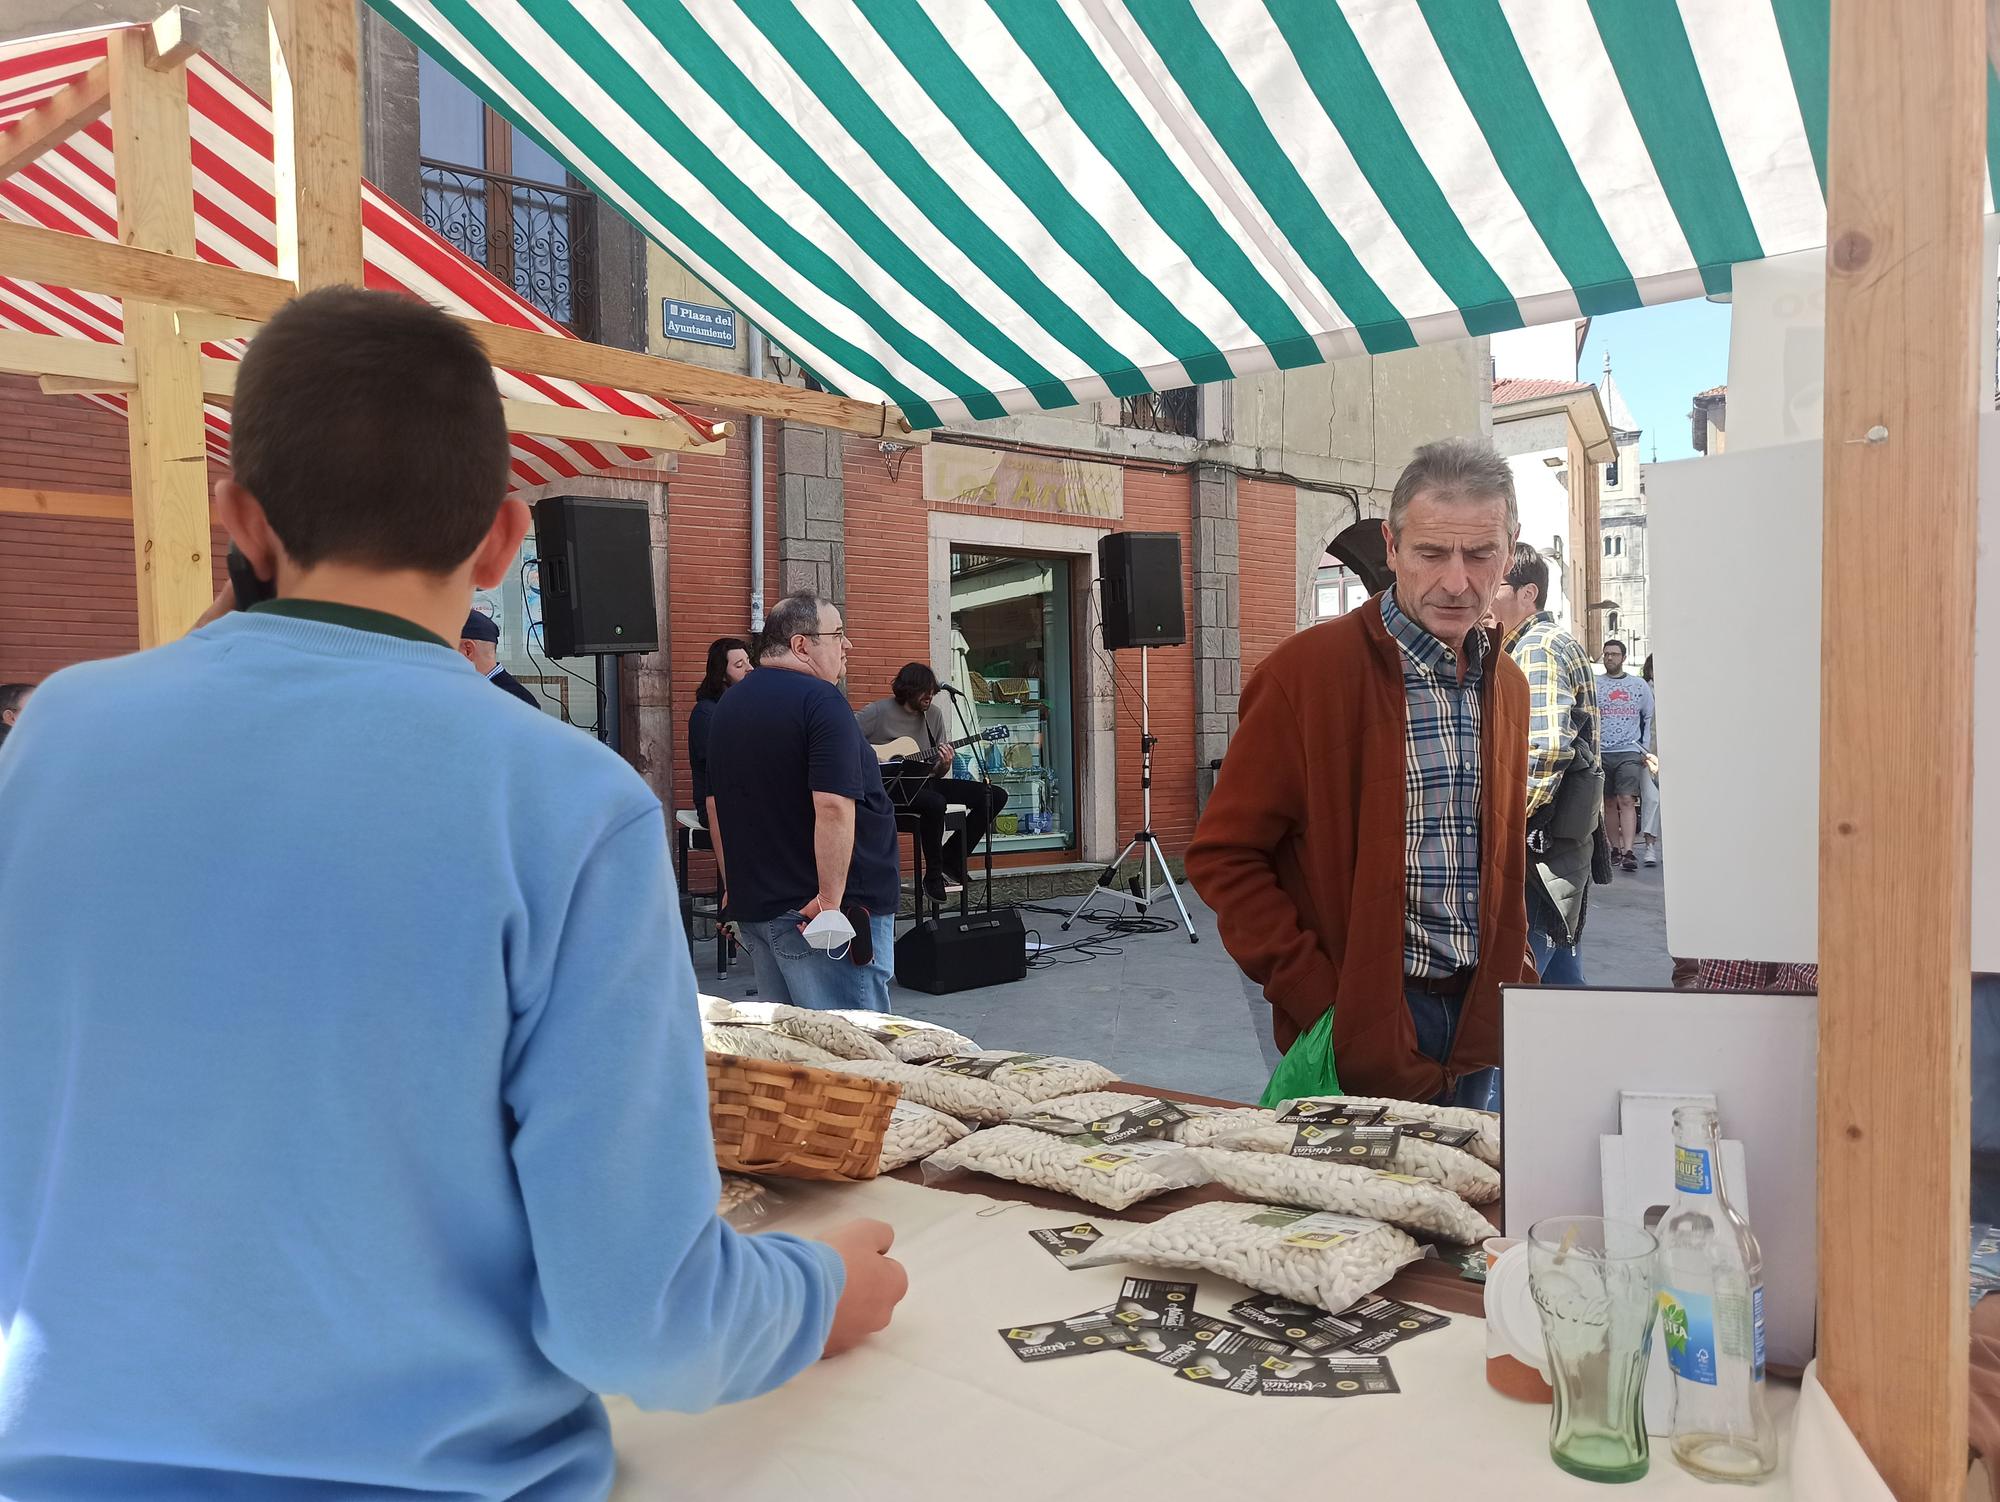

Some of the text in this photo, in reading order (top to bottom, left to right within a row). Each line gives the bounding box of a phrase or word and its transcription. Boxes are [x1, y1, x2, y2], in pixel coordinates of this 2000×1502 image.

[680, 308, 732, 326] Plaza del
[668, 320, 732, 340] Ayuntamiento
[1293, 1146, 1343, 1155] Asturias
[1018, 1341, 1076, 1356] Asturias
[1262, 1380, 1328, 1391] Asturias
